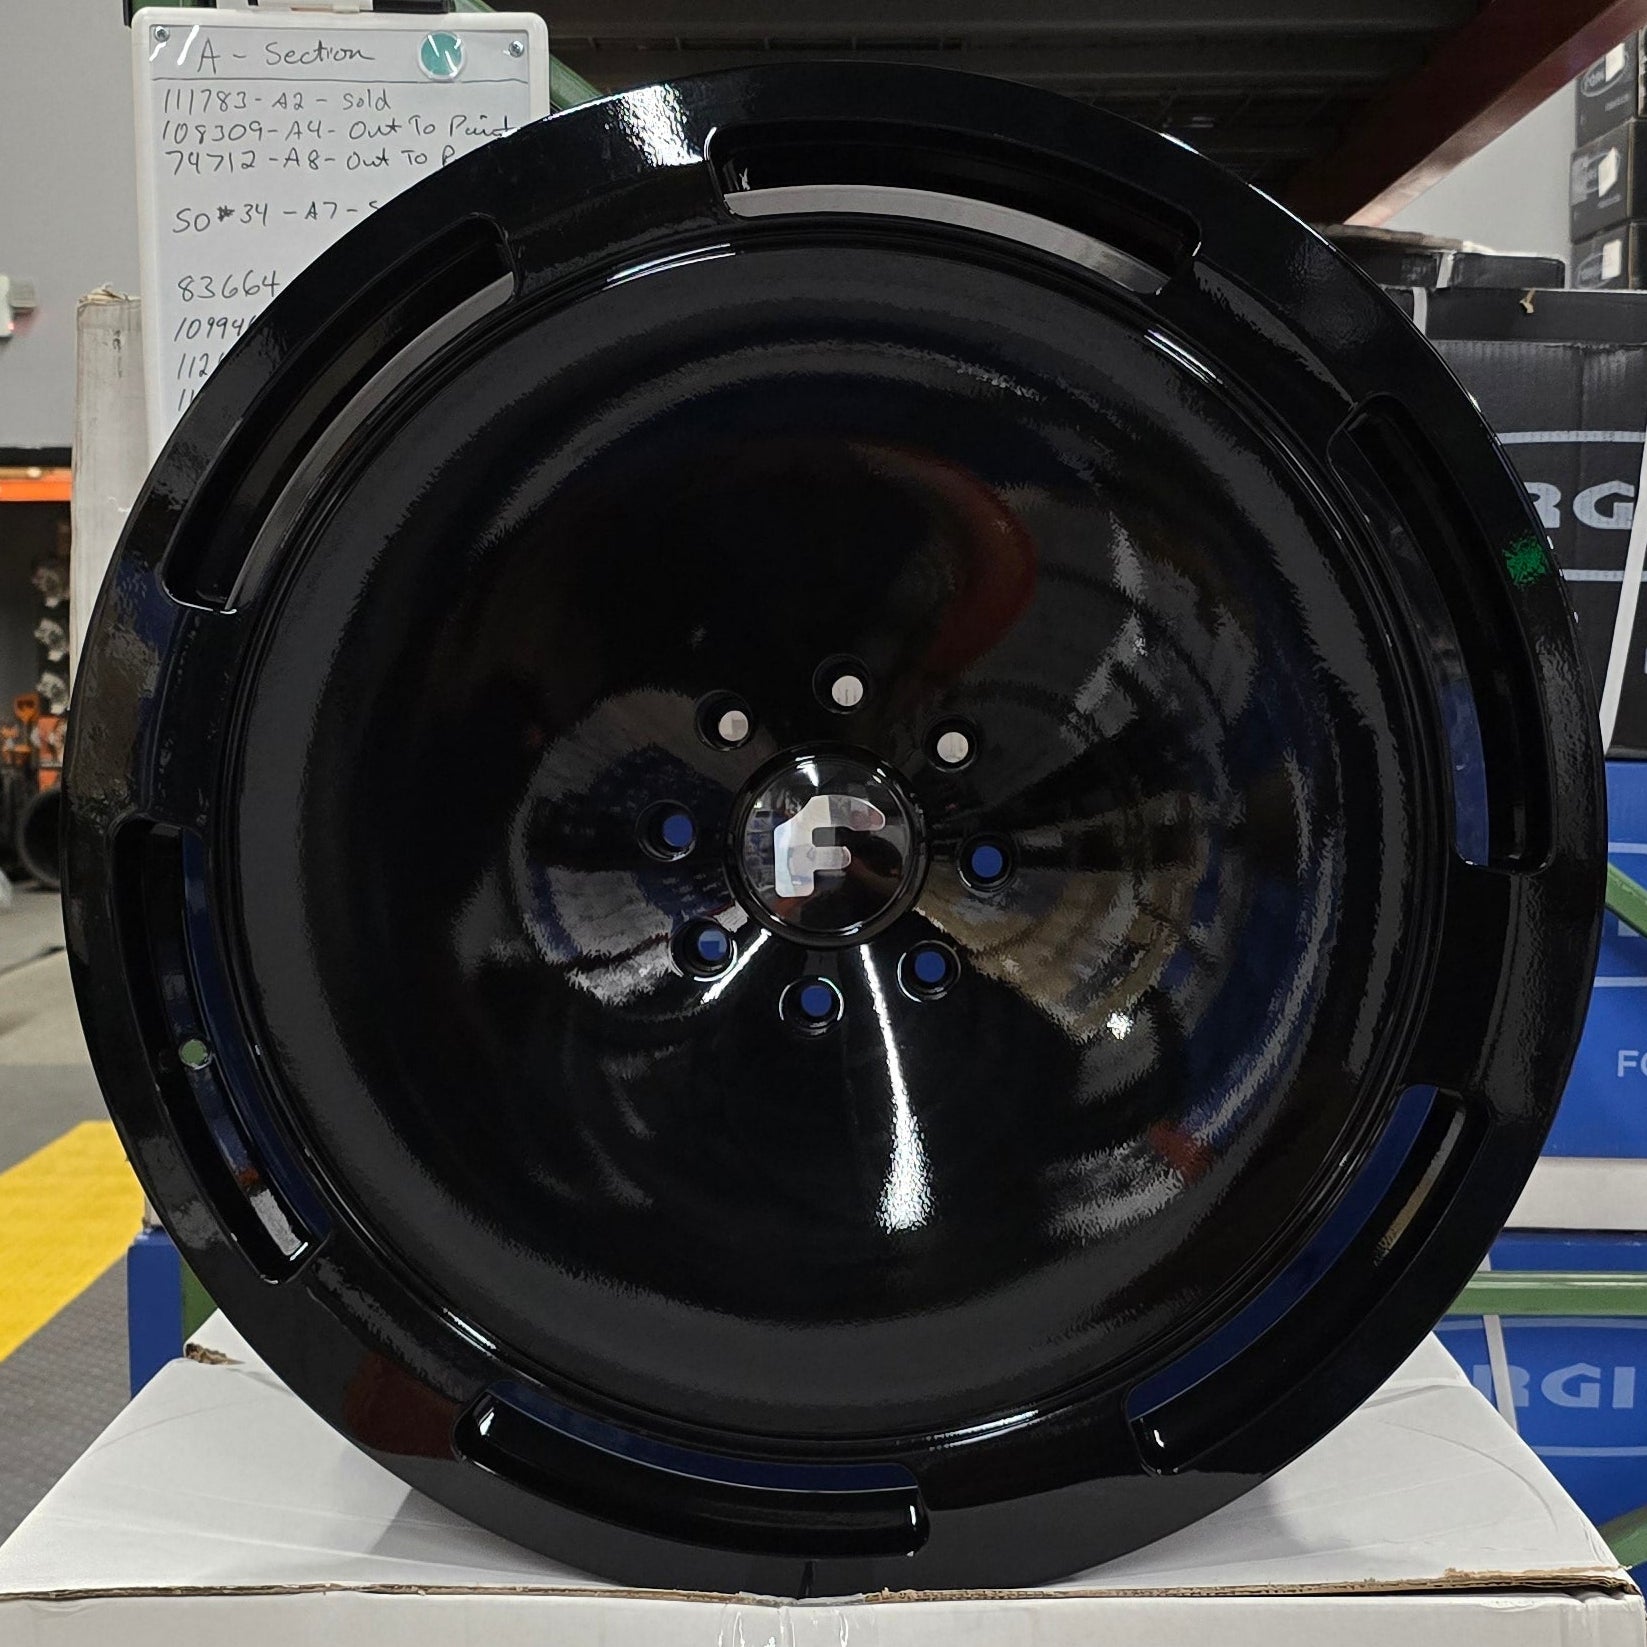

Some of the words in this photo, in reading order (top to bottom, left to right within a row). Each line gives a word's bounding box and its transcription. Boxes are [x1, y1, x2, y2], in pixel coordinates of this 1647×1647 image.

[197, 37, 222, 75] A
[265, 39, 376, 66] Section
[349, 117, 402, 140] Out
[408, 114, 436, 136] To
[346, 147, 390, 171] Out
[177, 270, 281, 302] 83664
